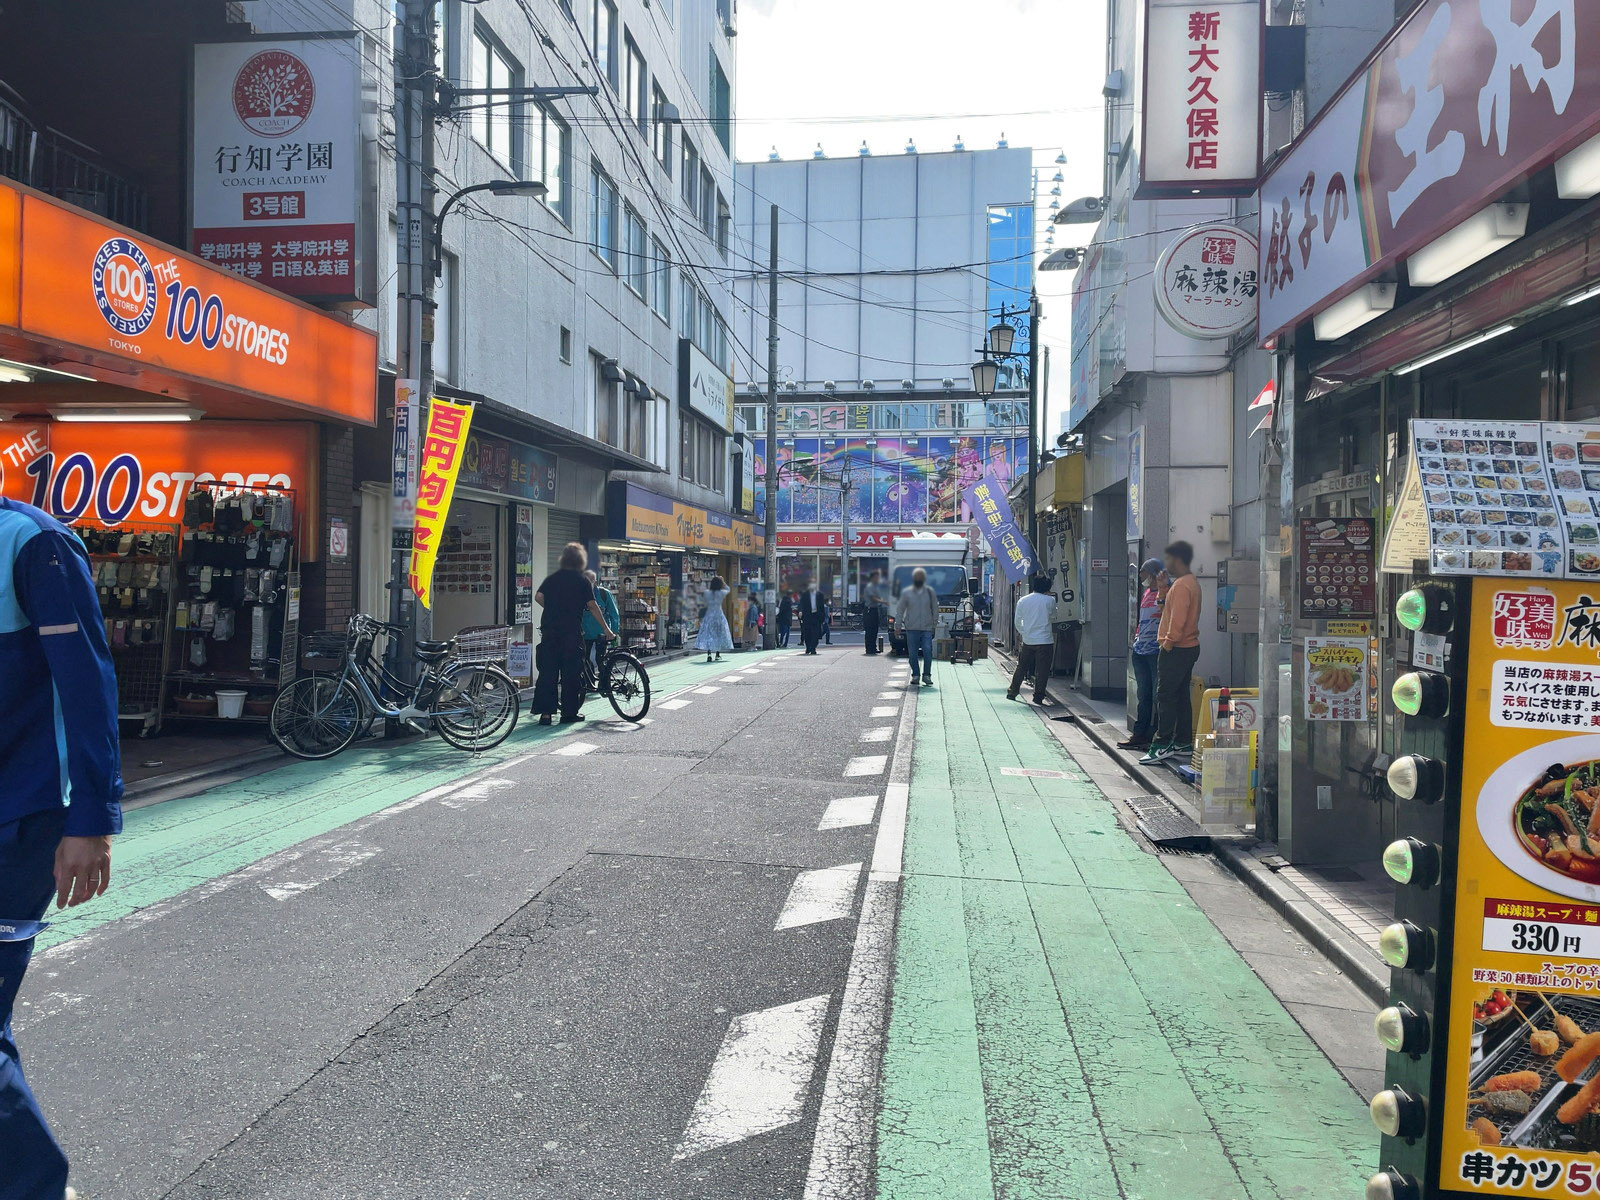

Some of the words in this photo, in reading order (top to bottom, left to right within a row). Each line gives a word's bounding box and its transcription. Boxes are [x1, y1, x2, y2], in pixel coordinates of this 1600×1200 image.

[1186, 11, 1220, 170] 新大久保店
[215, 141, 334, 174] 行知学園
[222, 177, 266, 187] COACH
[269, 175, 328, 186] ACADEMY
[250, 195, 299, 215] 3号館
[1264, 170, 1349, 299] 餃子の
[126, 242, 151, 276] THE
[200, 242, 262, 260] 学部升学
[271, 239, 349, 258] 大学院升学
[93, 240, 120, 310] STORES
[107, 261, 145, 303] 100
[153, 258, 181, 284] THE
[271, 260, 350, 278] 日语&英语
[1171, 264, 1258, 298] 麻辣湯
[109, 281, 156, 334] HUNDRED
[113, 297, 139, 313] STORES
[1183, 295, 1243, 308] マーラータン
[165, 279, 224, 351] 100
[222, 313, 289, 365] STORES
[108, 337, 142, 355] TOKYO
[4, 429, 47, 467] THE
[26, 452, 143, 527] 100
[408, 403, 467, 599] 百円均一セール
[777, 535, 809, 543] SLOT
[827, 534, 902, 545] EPAC
[1529, 595, 1547, 603] Hao
[1535, 622, 1551, 630] Mei
[1496, 638, 1552, 650] マーラータン
[1503, 681, 1600, 698] スパイスを使用し
[1462, 1151, 1600, 1194] 串カツ5
